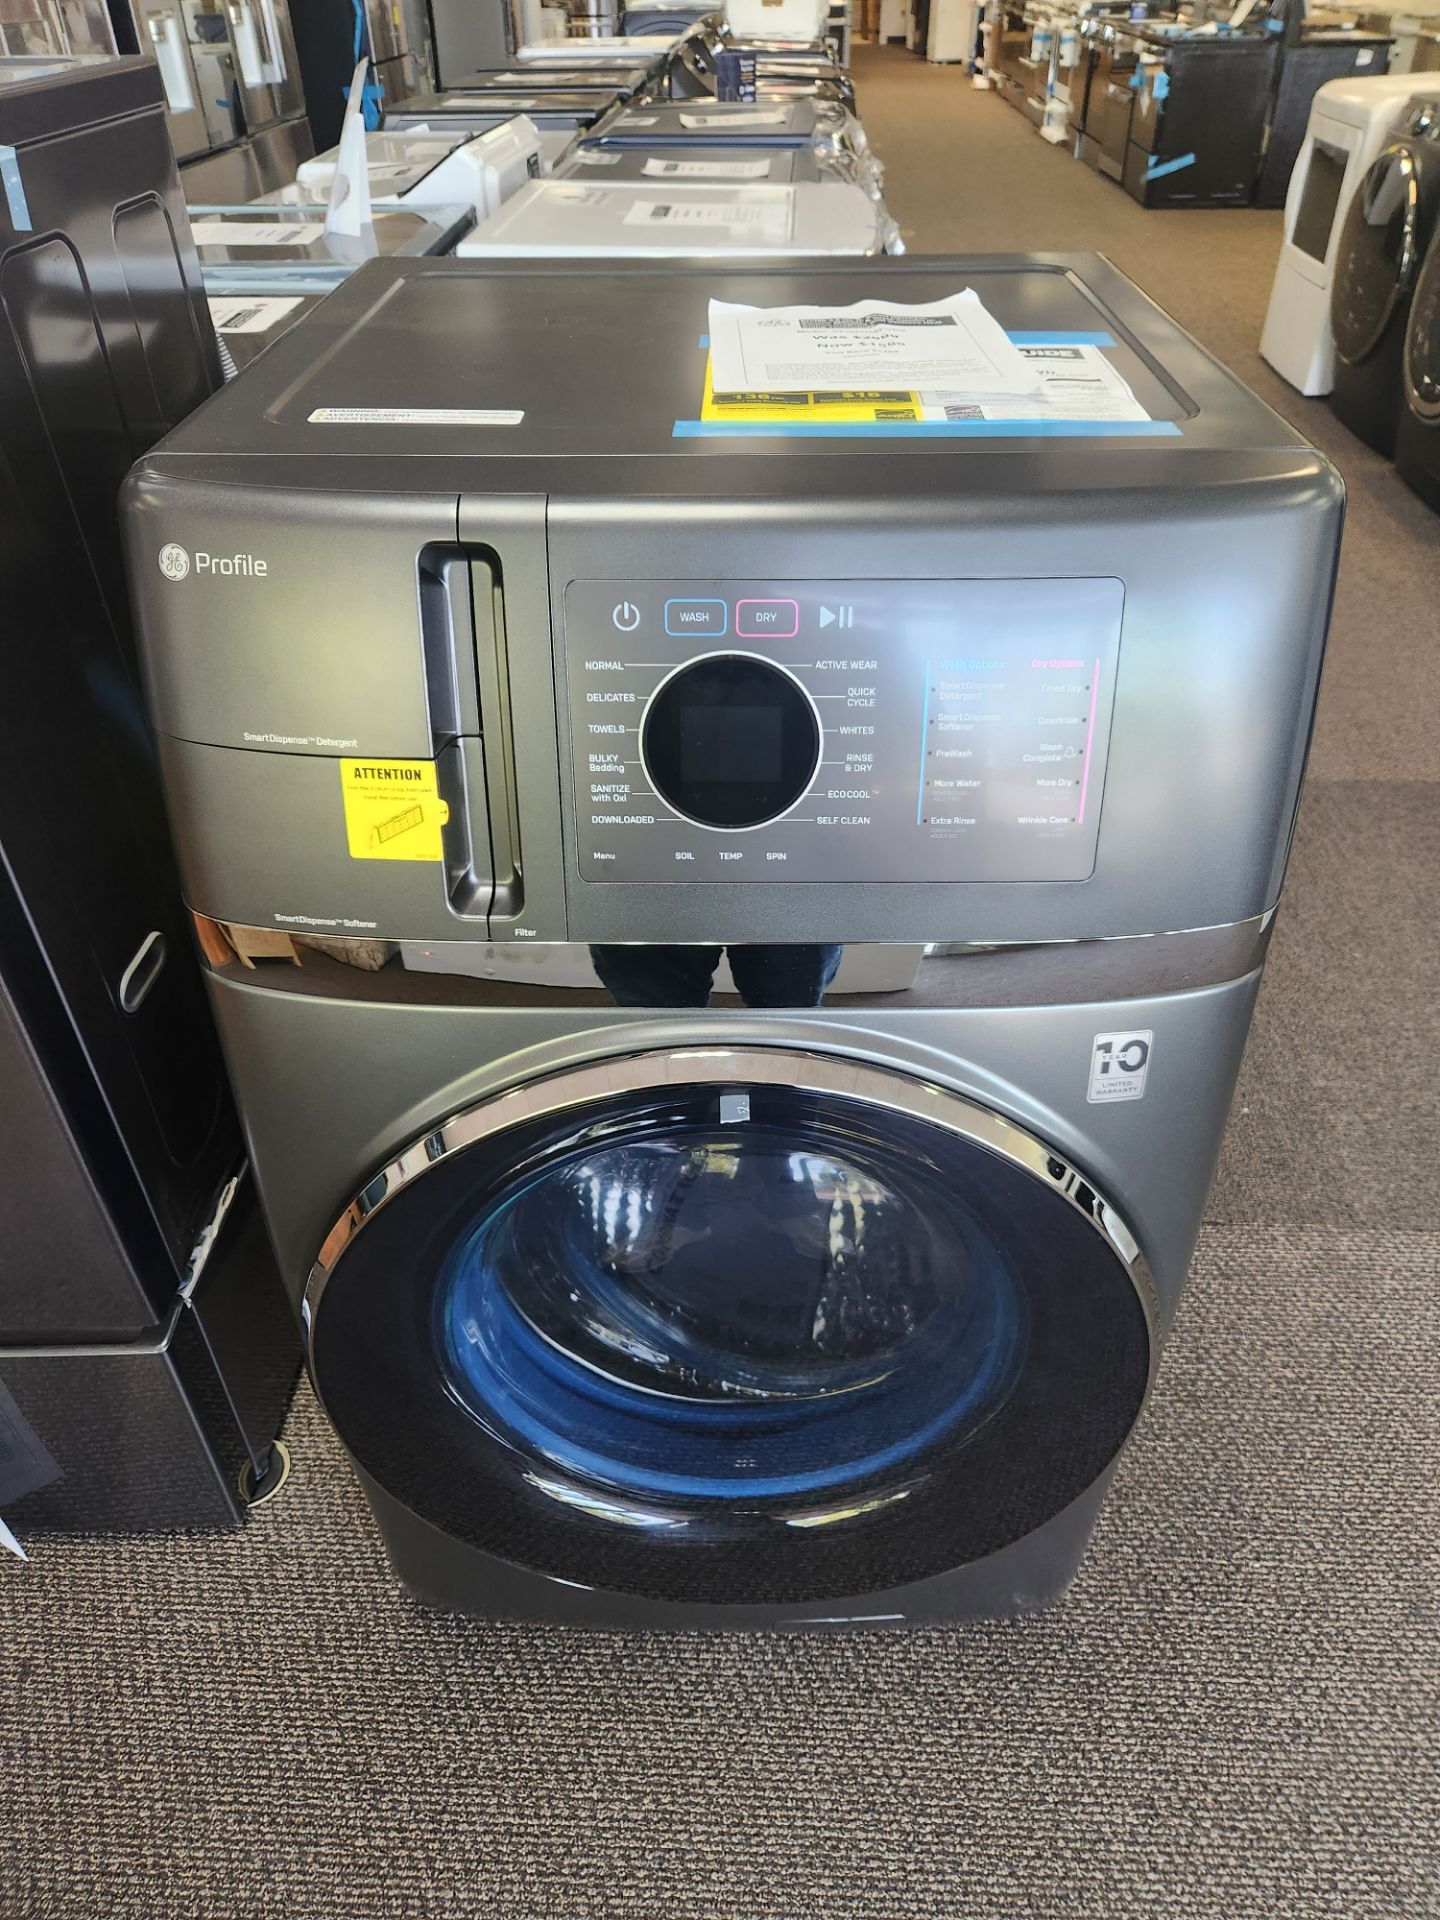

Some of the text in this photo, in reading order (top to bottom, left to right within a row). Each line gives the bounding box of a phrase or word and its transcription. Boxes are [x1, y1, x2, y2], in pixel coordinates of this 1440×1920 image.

[195, 552, 268, 576] Profile
[680, 612, 709, 622] WASH
[756, 612, 777, 622] DRY
[585, 661, 624, 670] NORMAL
[815, 661, 877, 670] ACTIVE WEAR
[847, 688, 876, 696] QUICK
[586, 693, 635, 702] DELICATES
[847, 699, 876, 707] CYCLE
[588, 725, 625, 733] TOWELS
[839, 726, 874, 735] WHITES
[316, 736, 358, 748] Detergent
[589, 754, 618, 762] BULKY
[846, 754, 873, 762] RINSE
[589, 764, 625, 773] Bedding
[845, 764, 873, 772] & DRY
[354, 767, 422, 781] ATTENTION
[956, 779, 981, 787] Water
[590, 785, 630, 793] SANITIZE
[591, 794, 627, 802] with Oxi
[591, 816, 654, 824] DOWNLOADED
[816, 816, 870, 825] SELF CLEAN
[593, 852, 616, 860] Menu
[675, 852, 695, 860] SOIL
[719, 852, 743, 860] TEMP
[766, 852, 787, 860] SPIN
[343, 919, 377, 928] Softener
[514, 928, 537, 937] Filter
[1095, 1040, 1149, 1074] 10
[1102, 1080, 1132, 1089] LIMITED
[1095, 1086, 1138, 1095] WARRANTY
